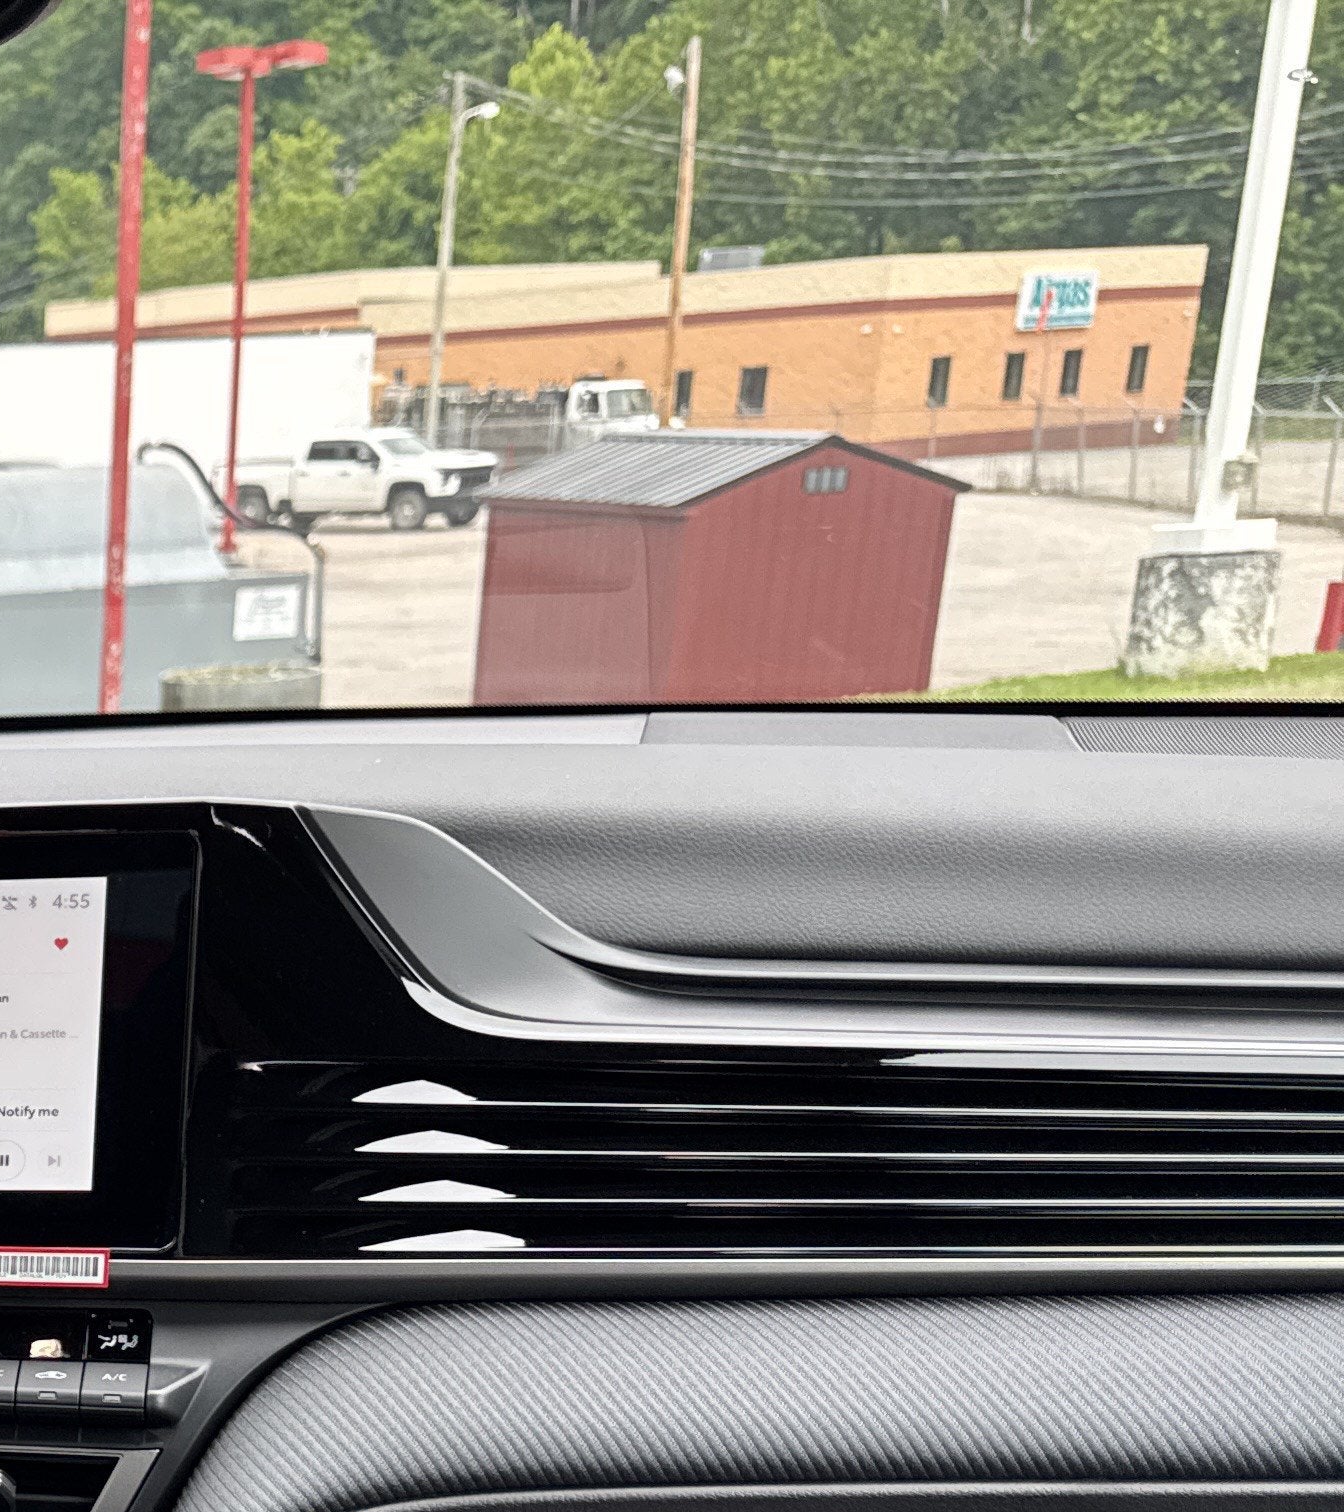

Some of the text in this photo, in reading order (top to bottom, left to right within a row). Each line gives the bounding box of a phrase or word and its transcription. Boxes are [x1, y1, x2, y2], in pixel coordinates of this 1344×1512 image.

[52, 894, 90, 909] 4:55
[20, 1029, 66, 1039] Cassette
[38, 1108, 60, 1117] me
[101, 1372, 127, 1382] A/C
